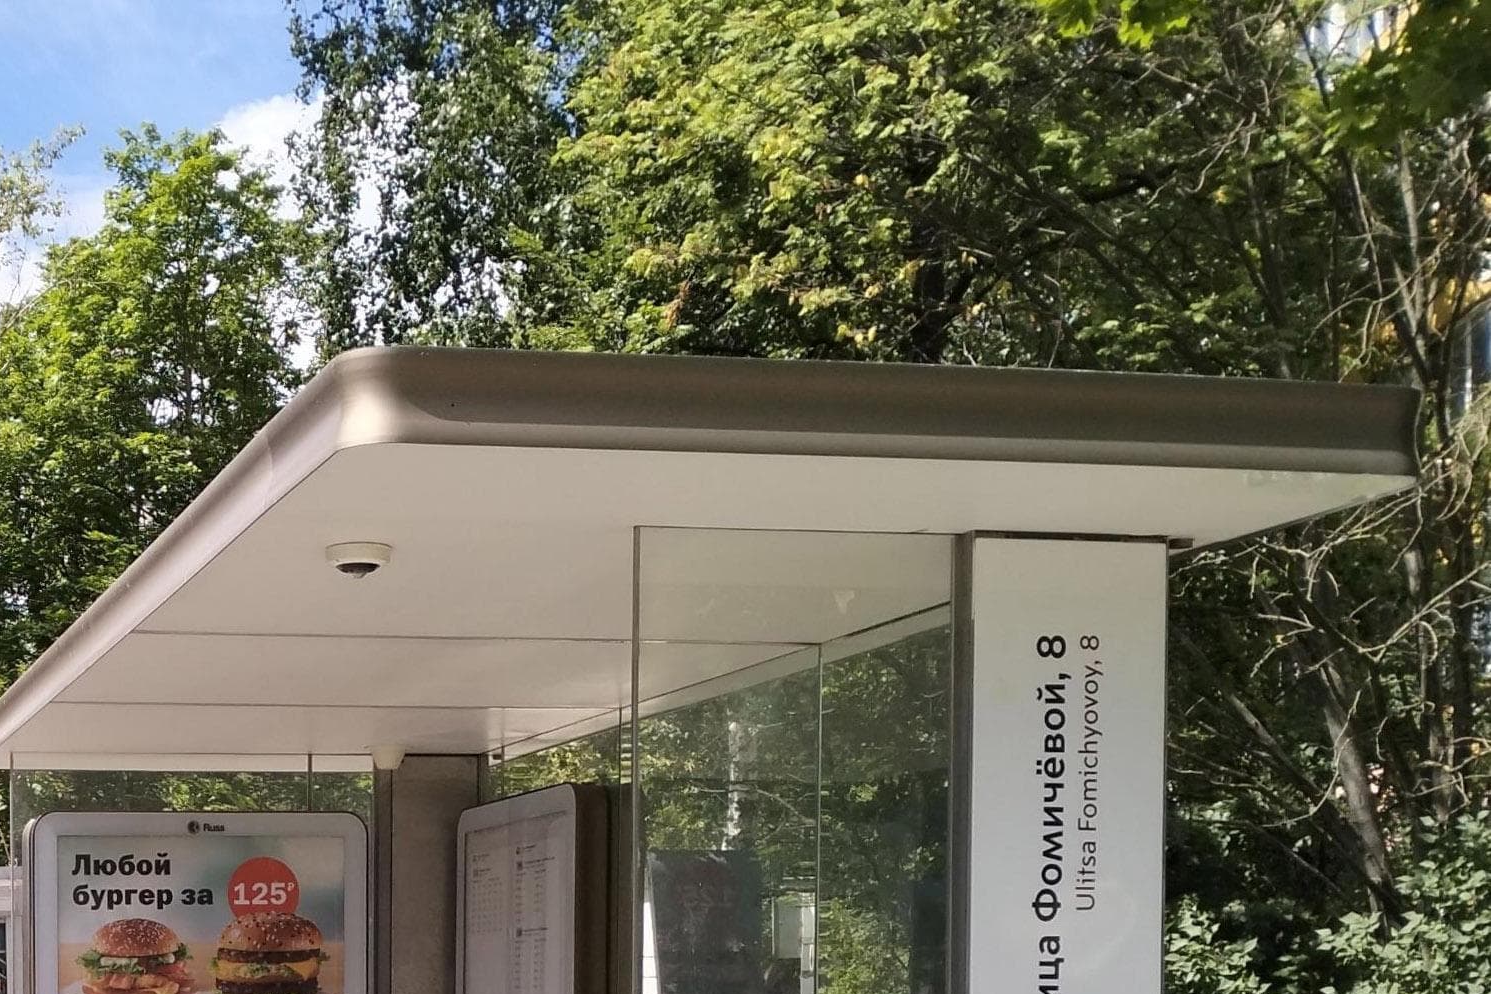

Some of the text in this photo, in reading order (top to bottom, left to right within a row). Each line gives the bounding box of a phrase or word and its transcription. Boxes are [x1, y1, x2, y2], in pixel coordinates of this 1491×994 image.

[1036, 634, 1067, 659] 8
[1076, 634, 1105, 911] Ulitsa Fomichyovoy, 8
[1032, 672, 1073, 923] Фомичёвой,
[71, 852, 171, 876] Любой
[72, 884, 214, 910] бургер за
